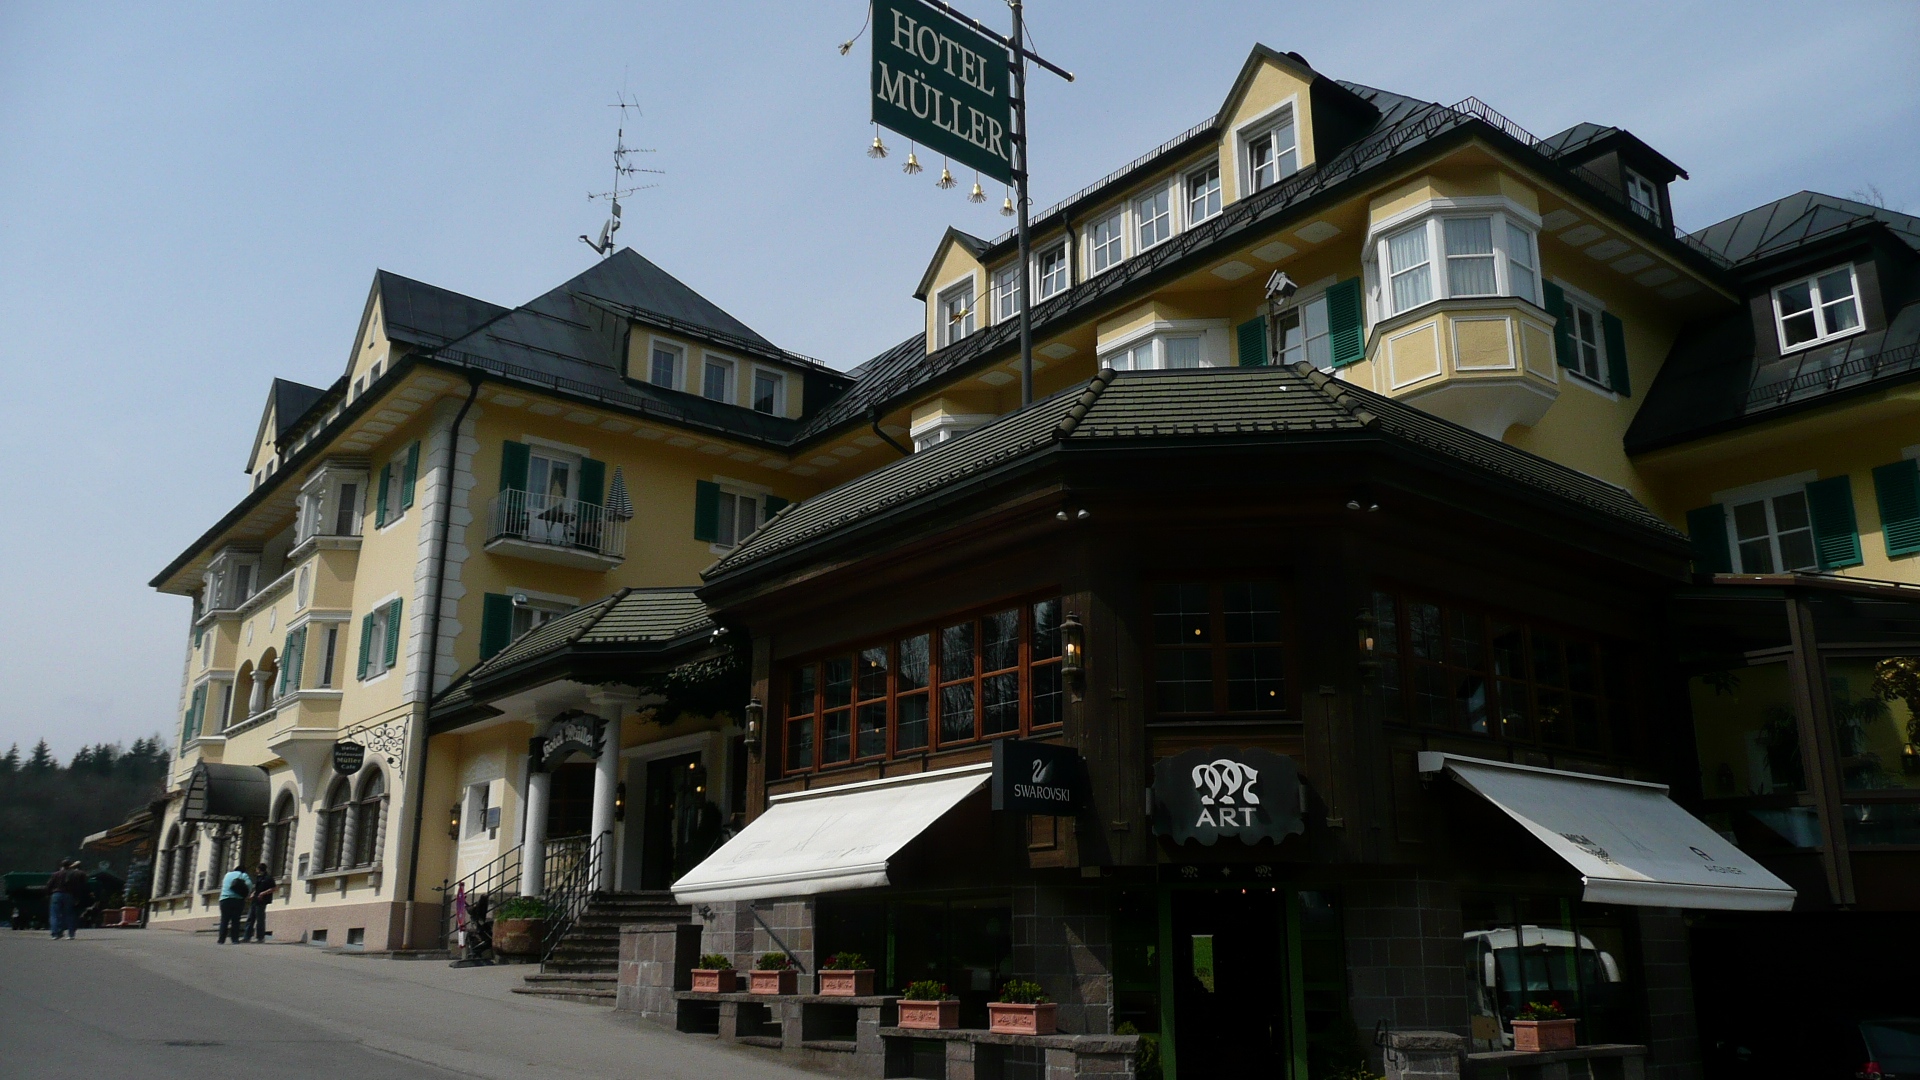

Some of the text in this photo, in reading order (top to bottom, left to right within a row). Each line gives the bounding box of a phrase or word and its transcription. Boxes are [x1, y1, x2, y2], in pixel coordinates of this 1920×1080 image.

[890, 7, 996, 97] HOTEL
[877, 60, 1009, 162] MÜLLER
[1014, 783, 1070, 802] SWAROVSKI
[1195, 807, 1257, 828] ART
[1704, 864, 1747, 876] AIGNER
